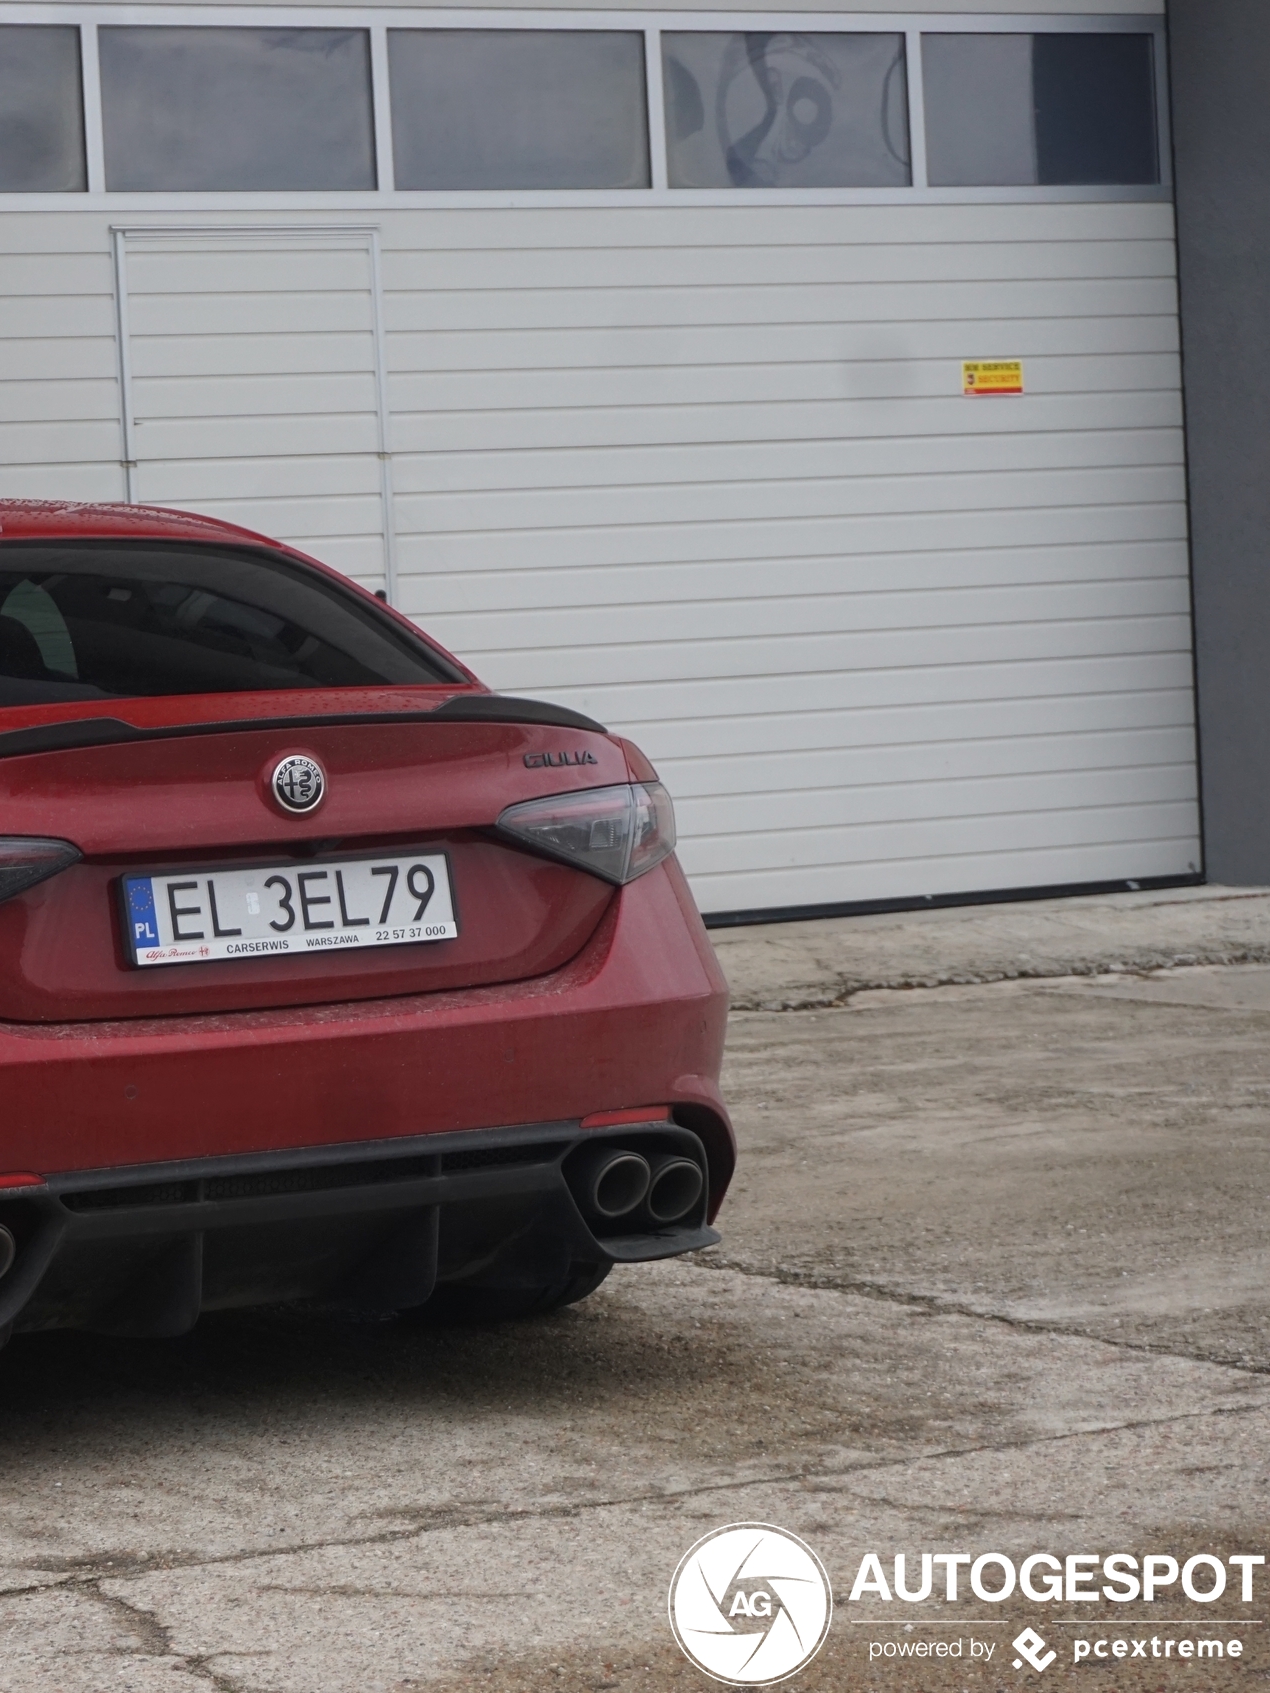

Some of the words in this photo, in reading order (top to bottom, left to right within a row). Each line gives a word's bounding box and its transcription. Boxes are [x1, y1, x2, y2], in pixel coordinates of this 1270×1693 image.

[277, 763, 292, 785] ALFA
[294, 759, 321, 783] ROMEO
[524, 750, 598, 768] GIULIA
[167, 880, 242, 941] EL
[263, 864, 435, 932] 3EL79
[135, 922, 155, 939] PL
[146, 950, 167, 962] Alfa
[168, 948, 196, 957] Romeo
[226, 940, 290, 954] CARSERWIS
[306, 935, 359, 947] WARSZAWA
[376, 931, 389, 941] 22
[392, 929, 405, 939] 57
[409, 927, 422, 938] 37
[425, 925, 446, 936] 000
